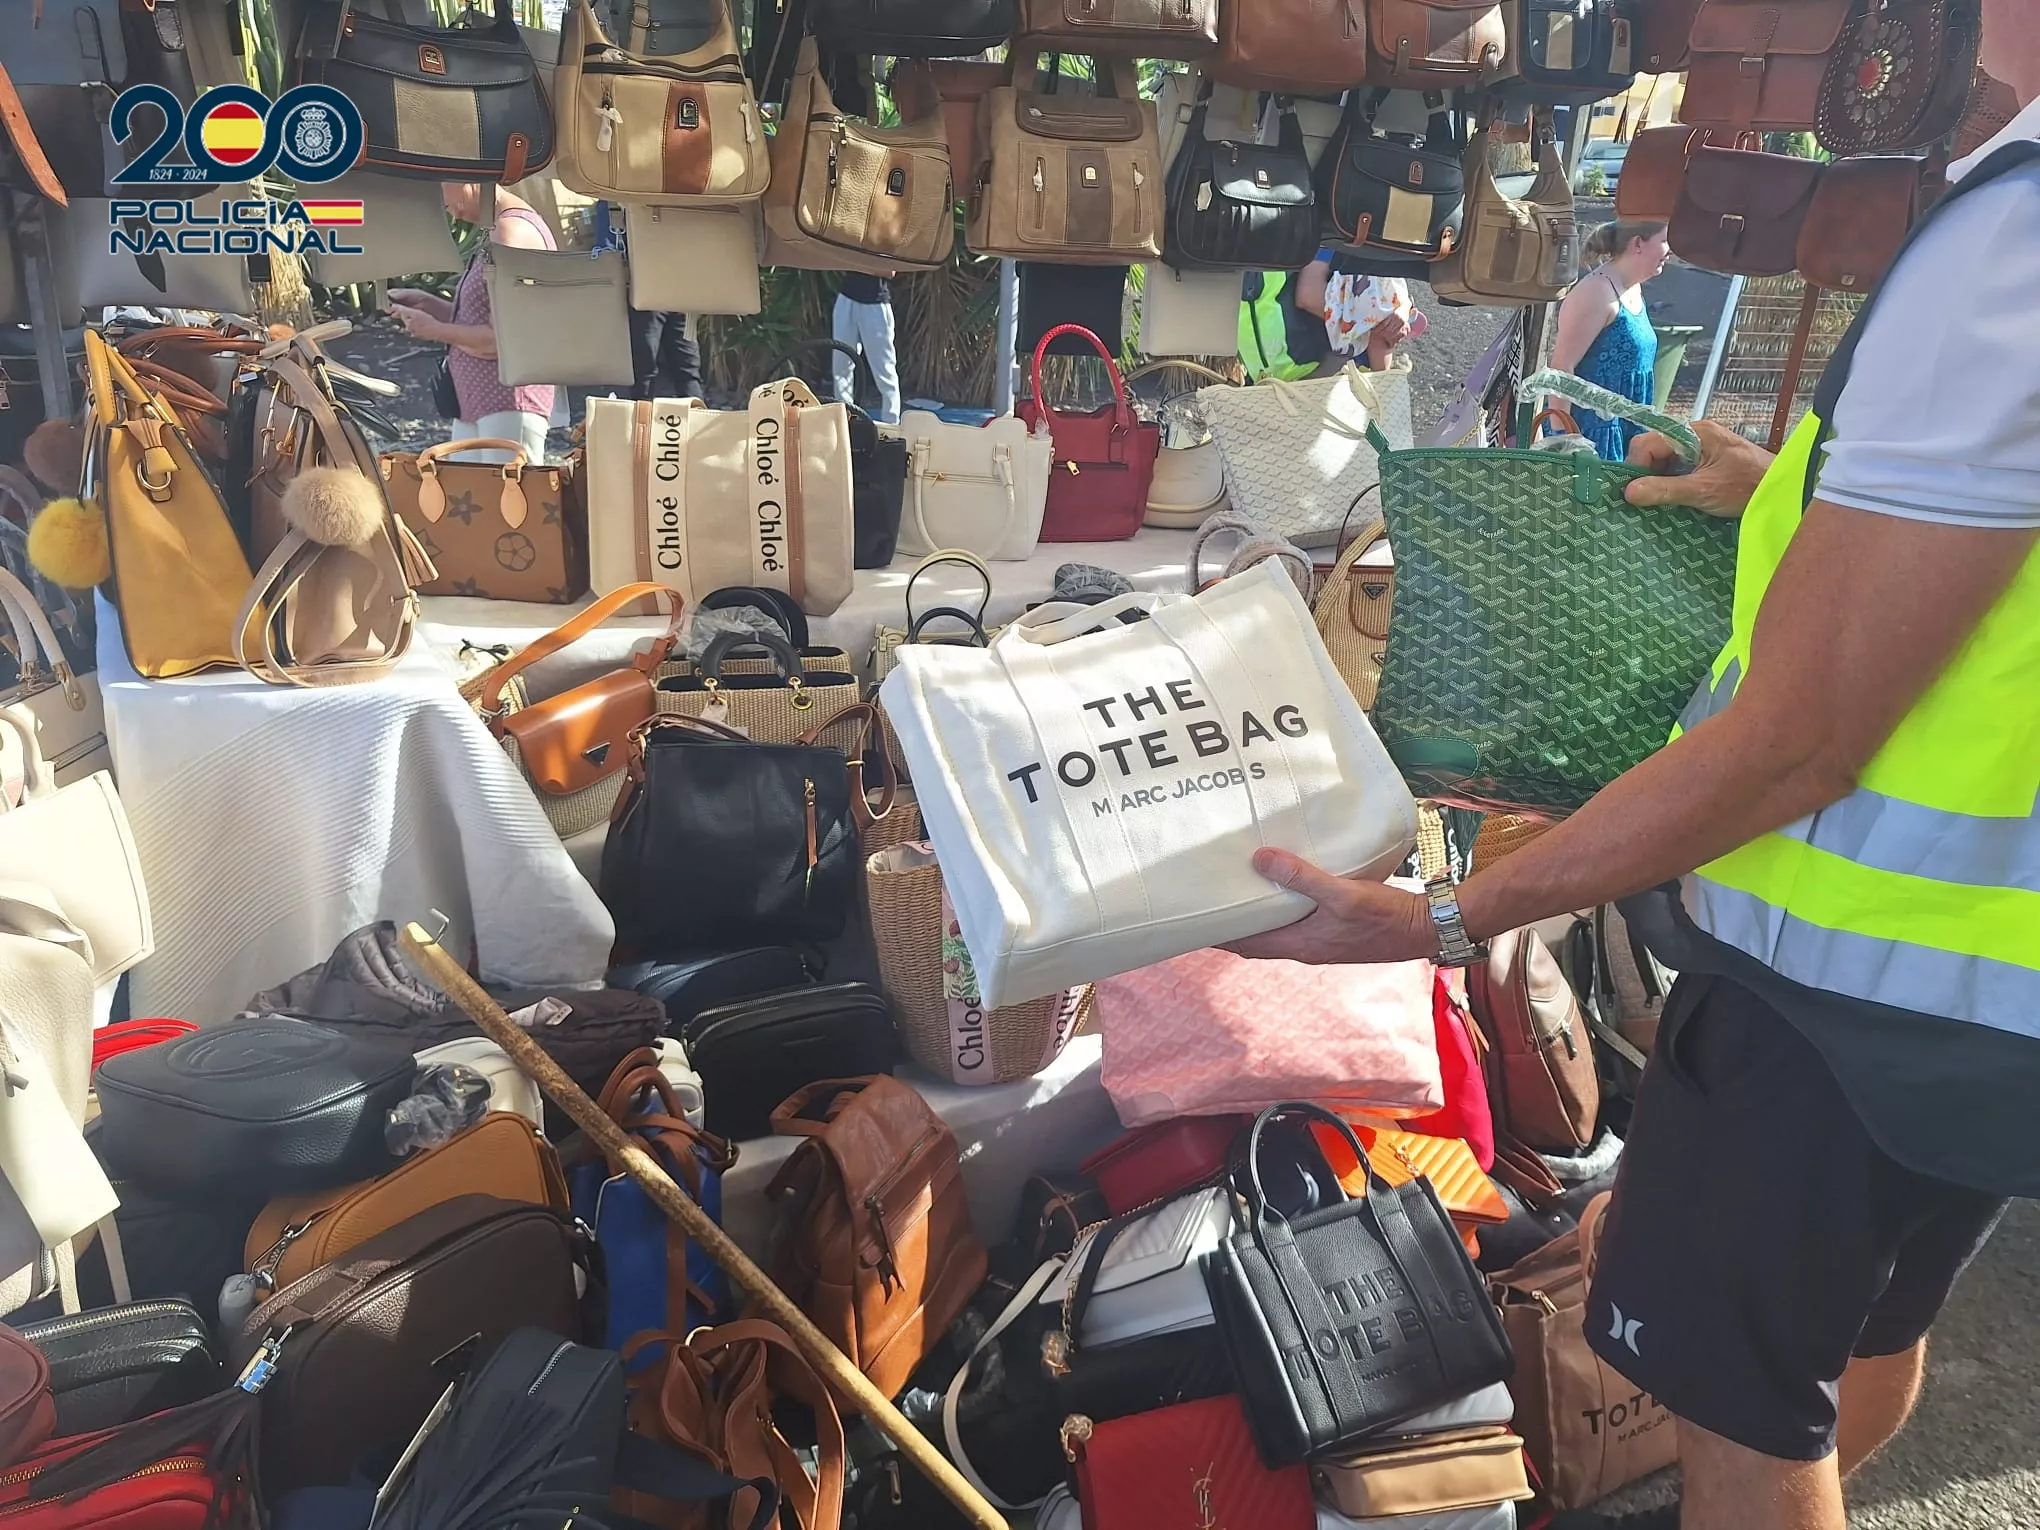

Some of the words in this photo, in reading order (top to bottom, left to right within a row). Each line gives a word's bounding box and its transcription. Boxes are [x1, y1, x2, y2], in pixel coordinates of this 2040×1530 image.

[655, 414, 682, 482] Chloé
[756, 417, 779, 486] Chloé
[656, 496, 682, 570] Chloé
[757, 500, 784, 572] Chloé
[1083, 679, 1206, 728] THE
[1007, 729, 1179, 804] TOTE
[1186, 704, 1309, 758] BAG
[1091, 785, 1168, 818] MARC
[1172, 762, 1266, 799] JACOBS
[1322, 1266, 1406, 1316] THE
[1282, 1315, 1391, 1381] TOTE
[1394, 1289, 1476, 1343] BAG
[1617, 1421, 1652, 1444] MARC
